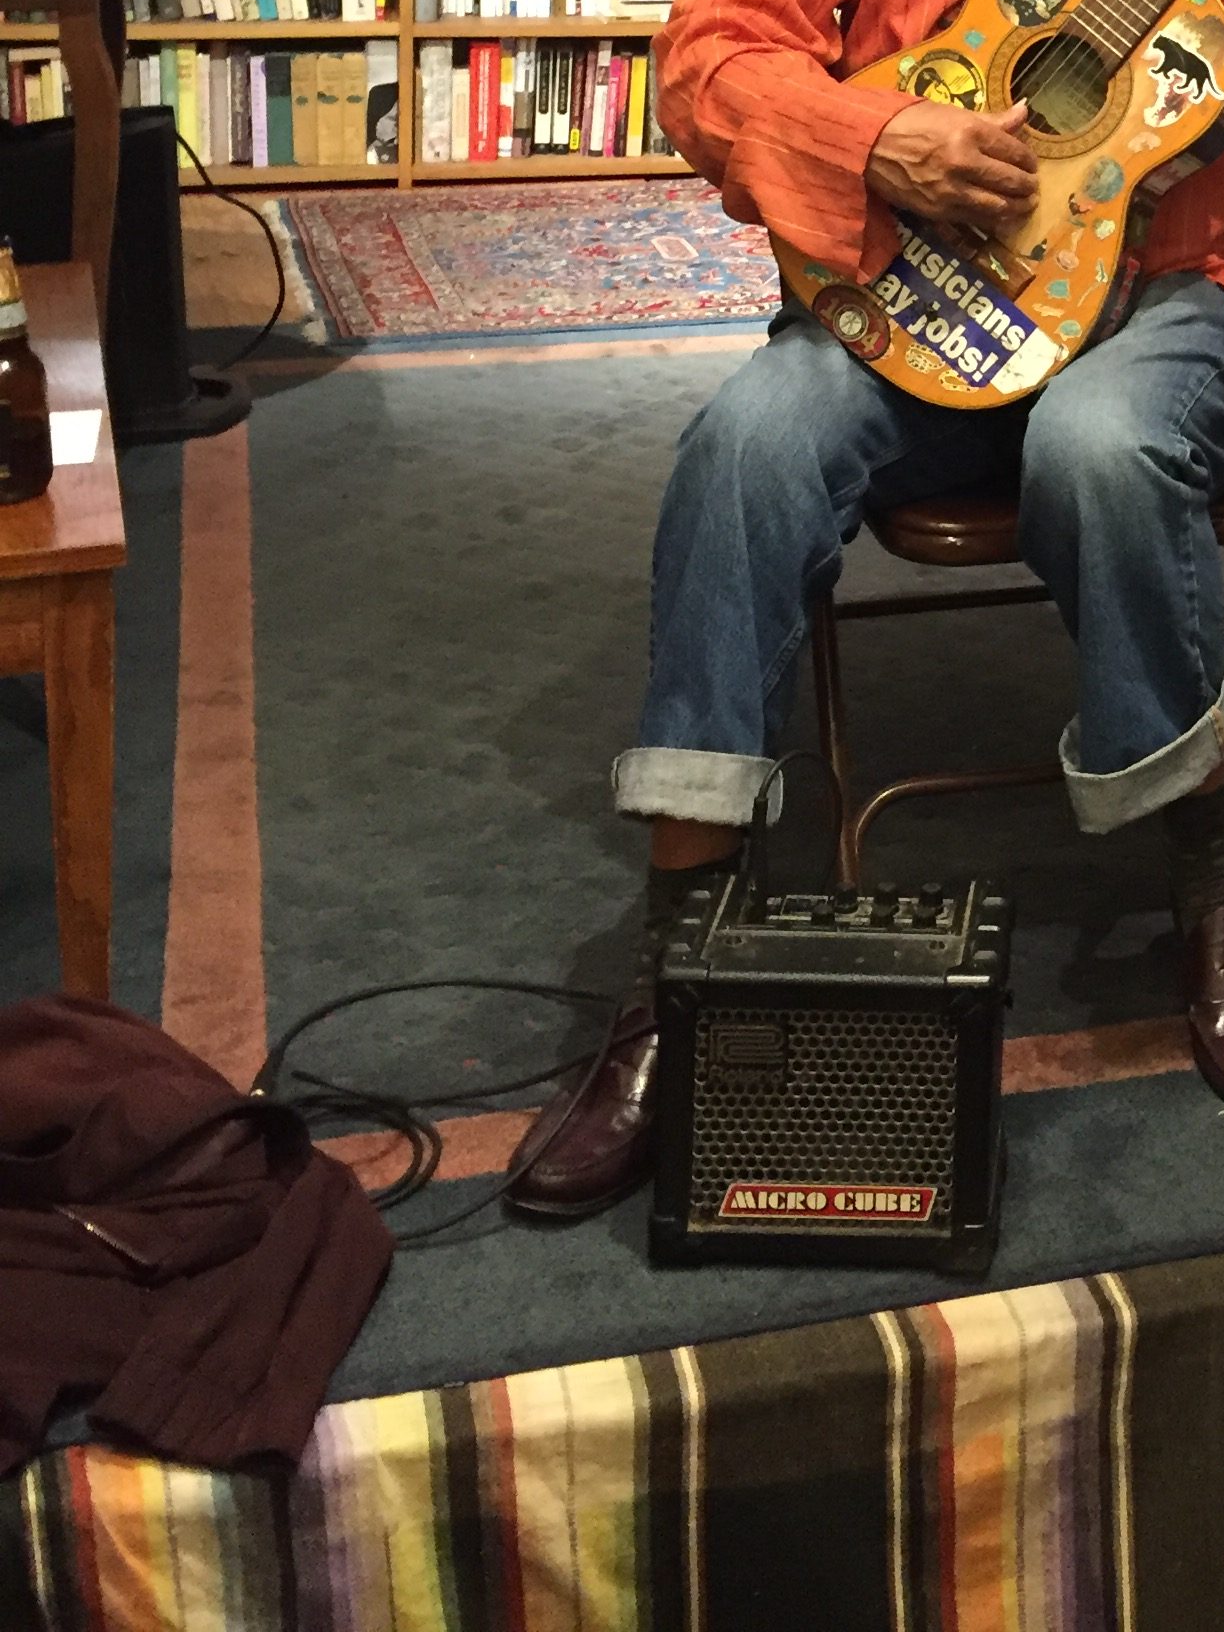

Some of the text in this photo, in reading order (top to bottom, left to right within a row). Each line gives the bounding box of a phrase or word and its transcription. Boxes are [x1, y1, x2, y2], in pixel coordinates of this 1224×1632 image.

[874, 274, 919, 317] ay
[906, 300, 999, 382] jobs!
[730, 1190, 922, 1213] MICRO CUBE
